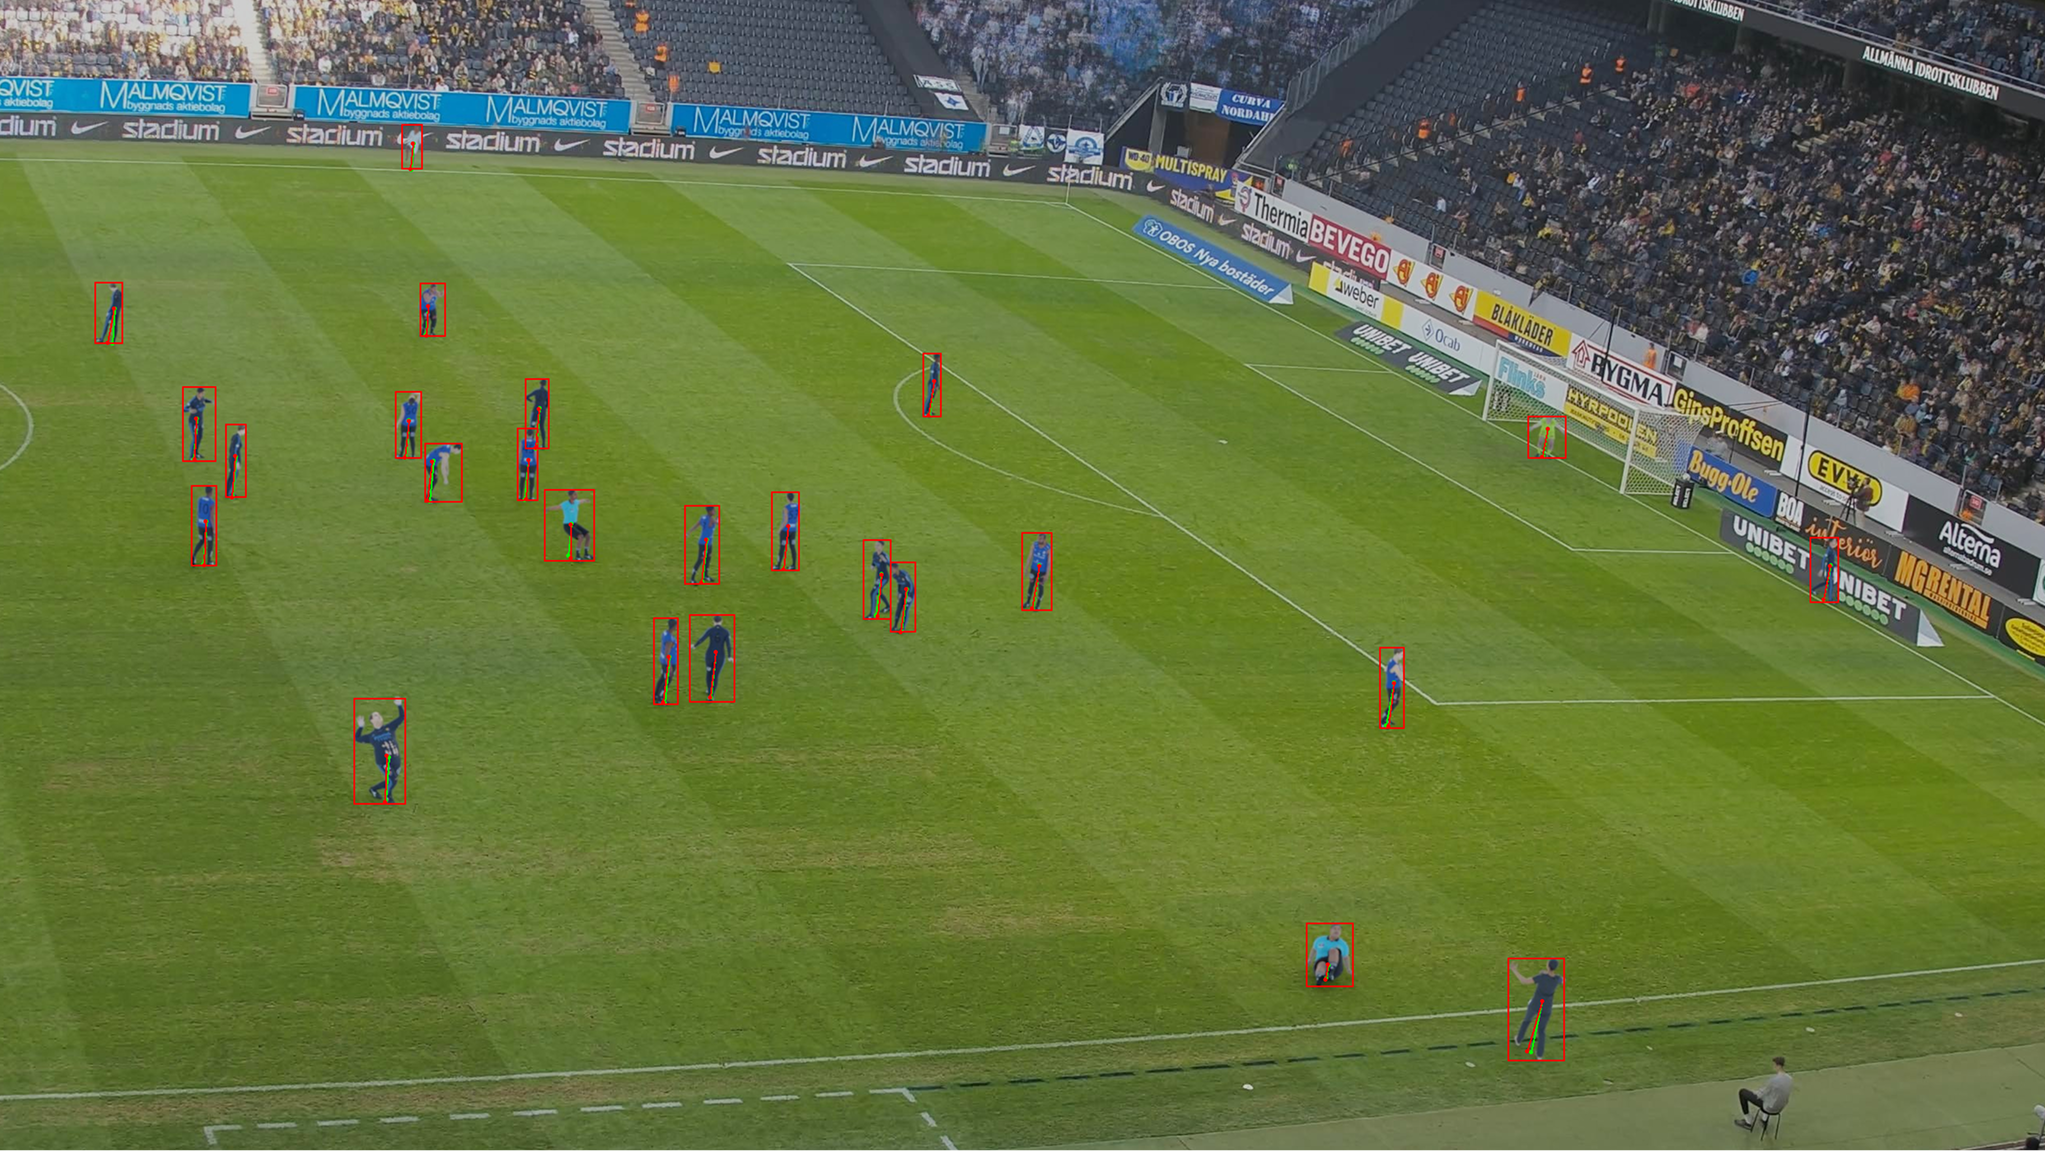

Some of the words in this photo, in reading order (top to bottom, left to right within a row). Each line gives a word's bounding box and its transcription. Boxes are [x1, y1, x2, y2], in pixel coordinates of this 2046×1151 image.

[1862, 45, 1914, 73] ALLMÄNNA
[1914, 61, 2000, 100] IDROTTSKLUBBEN
[100, 80, 226, 109] MALMQVIST
[127, 101, 173, 113] byggnads
[176, 102, 225, 114] aktiebolag
[317, 88, 443, 117] MALMQVIST
[1231, 94, 1271, 108] CURVA
[344, 109, 388, 120] byggnads
[391, 110, 441, 122] aktiebolag
[486, 95, 607, 124] MALMQVIST
[512, 115, 557, 127] byggnads
[559, 117, 606, 130] aktiebolag
[693, 106, 810, 134] MALMQVIST
[122, 118, 220, 141] stadium
[286, 121, 384, 147] stadium
[445, 131, 541, 154] stadium
[764, 129, 809, 140] aktiebolag
[852, 116, 965, 143] MALMQVIST
[602, 137, 696, 161] stadium
[757, 144, 847, 169] stadium
[904, 154, 991, 178] stadium
[1046, 165, 1133, 191] stadium
[1155, 154, 1228, 183] MULTISPRAY
[1169, 188, 1215, 224] stadium
[1253, 192, 1309, 239] Thermia
[1241, 222, 1292, 260] stadium
[1309, 219, 1391, 274] BEVEGO
[1159, 230, 1195, 254] OBOS
[1195, 247, 1218, 268] Nya
[1218, 258, 1275, 297] bostäder
[1343, 284, 1380, 310] weber
[1353, 324, 1410, 354] UNIBET
[1491, 303, 1554, 347] BLÅKLÄDER
[1435, 329, 1461, 352] Ocab
[1408, 352, 1470, 383] UNIBET
[1498, 356, 1546, 399] Flinks
[1673, 389, 1784, 462] GipsProffsen
[1777, 492, 1804, 528] BOA
[1732, 515, 1810, 572] UNIBET
[1938, 521, 2002, 568] Alterna
